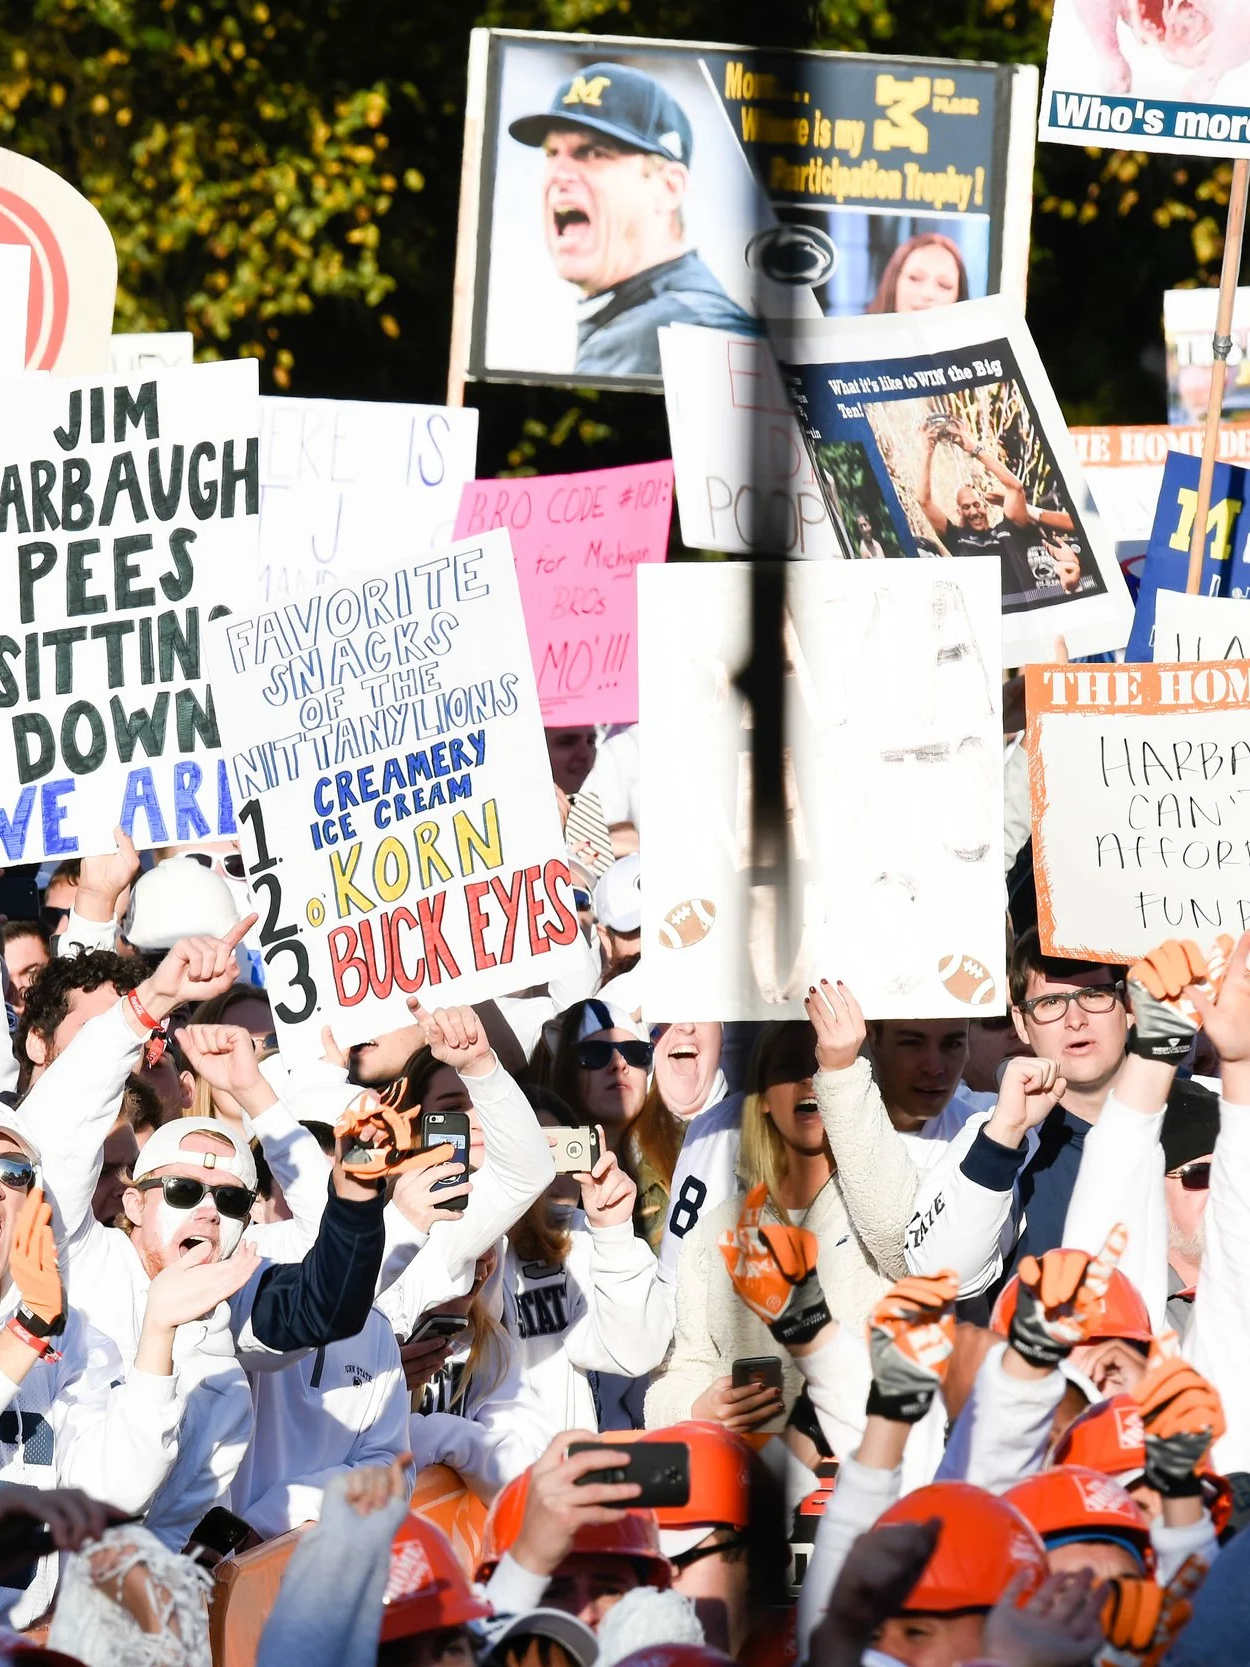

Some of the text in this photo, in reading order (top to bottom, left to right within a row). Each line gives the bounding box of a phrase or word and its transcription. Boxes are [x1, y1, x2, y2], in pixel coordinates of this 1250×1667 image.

[1055, 92, 1166, 135] Who's
[827, 378, 862, 396] What
[877, 374, 904, 392] like
[903, 373, 918, 390] to
[913, 367, 948, 388] WIN
[947, 364, 973, 383] the
[972, 358, 1004, 378] Big
[836, 401, 865, 420] Ten!
[53, 380, 160, 451] JIM
[467, 489, 532, 533] BRO
[547, 484, 608, 524] CODE
[18, 526, 198, 625] PEES
[226, 548, 490, 675] FAVORITE
[262, 611, 460, 707] SNACKS
[1043, 670, 1143, 707] THE
[300, 660, 443, 731] OF THE
[11, 683, 222, 785] DOWN
[313, 729, 487, 817] CREAMERY
[1128, 786, 1250, 830] CAN'
[309, 811, 357, 851] ICE
[373, 773, 474, 830] CREAM
[327, 890, 462, 1008] BUCK
[463, 858, 580, 972] EYES
[669, 1174, 707, 1240] 8
